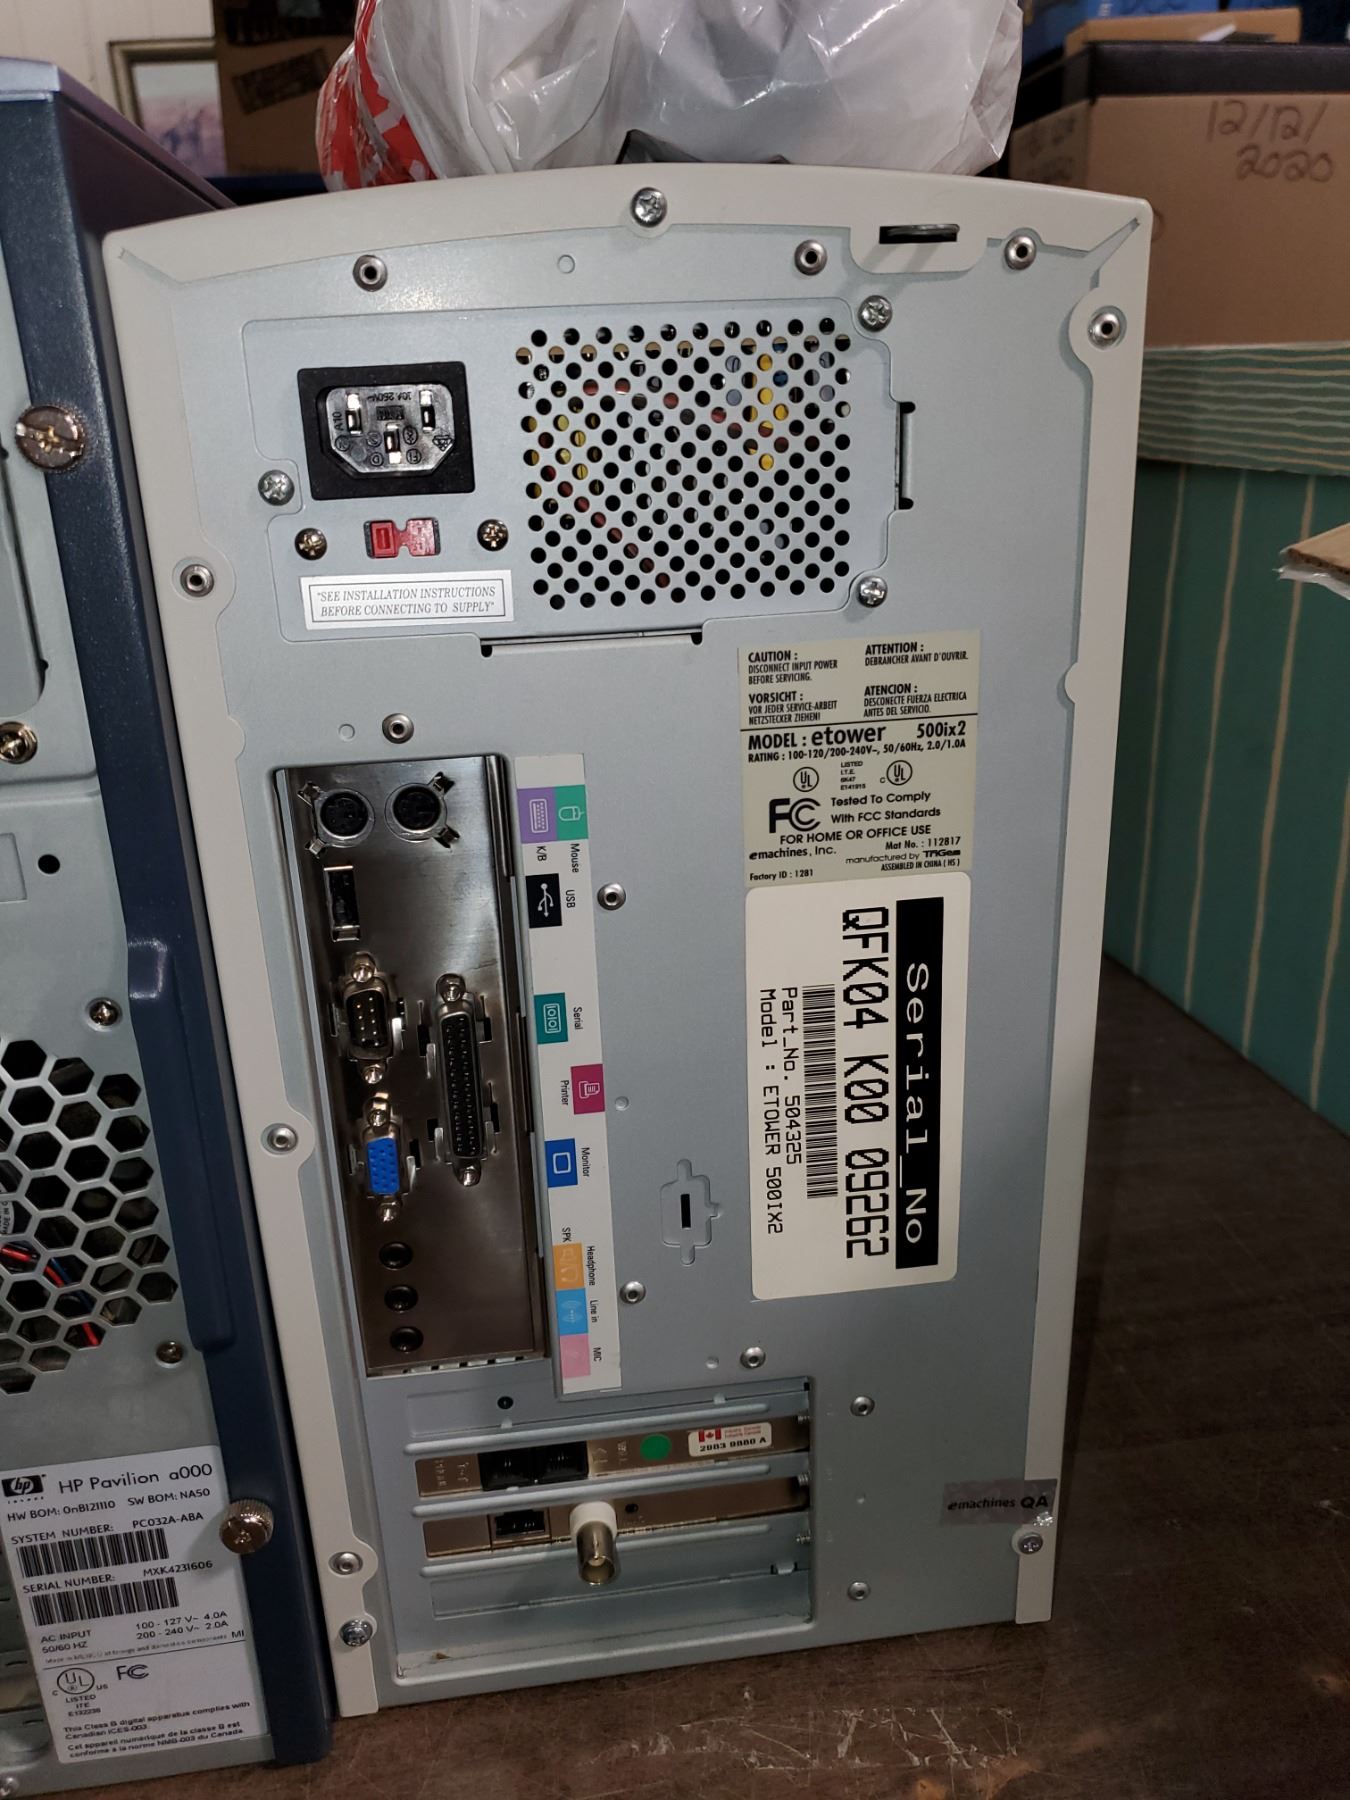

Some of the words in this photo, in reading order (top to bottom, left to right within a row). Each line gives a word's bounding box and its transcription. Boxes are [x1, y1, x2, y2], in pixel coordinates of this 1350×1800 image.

[1236, 144, 1335, 182] 2020
[343, 588, 418, 601] INSTALLATION
[420, 586, 496, 599] INSTRUCTIONS
[321, 605, 362, 617] BEFORE
[364, 602, 431, 616] CONNECTING
[434, 602, 448, 614] TO
[865, 641, 918, 655] ATTENTION
[748, 650, 791, 663] CAUTION
[865, 654, 909, 666] DEBRANCHER
[911, 653, 932, 663] AVANT
[748, 662, 790, 674] DISCONNECT
[792, 661, 812, 671] INPUT
[814, 660, 838, 670] POWER
[748, 674, 774, 685] BEFORE
[749, 691, 797, 704] VORSICHT
[864, 683, 912, 697] ATENCION
[864, 696, 905, 707] DESCONECTE
[907, 694, 932, 704] FUERZA
[934, 692, 967, 702] ELECTRICA
[749, 706, 762, 715] VOR
[765, 704, 784, 714] JEDER
[786, 700, 838, 712] SERVICE-ARBEIT
[864, 708, 884, 718] ANTES
[886, 706, 898, 716] DEL
[749, 714, 792, 726] NETZSTECKER
[748, 732, 797, 750] MODEL
[811, 726, 886, 747] etower
[917, 720, 966, 739] 500ix2
[748, 752, 779, 763] RATING
[927, 738, 966, 751] 2.0/1.0A
[831, 795, 867, 806] Tested
[870, 794, 882, 804] To
[886, 791, 931, 803] Comply
[830, 813, 854, 824] With
[858, 811, 882, 822] FCC
[885, 807, 941, 820] Standards
[780, 834, 804, 844] FOR
[807, 831, 842, 843] HOME
[846, 830, 863, 840] OR
[866, 826, 908, 838] OFFICE
[911, 825, 931, 835] USE
[886, 842, 902, 850] Mat
[904, 840, 918, 848] No.
[928, 836, 961, 847] 112817
[536, 846, 547, 862] K/B
[570, 843, 580, 873] Mouse
[815, 846, 836, 856] Inc.
[846, 852, 907, 864] manufactured
[909, 852, 920, 861] by
[881, 862, 914, 871] ASSEMBLED
[924, 860, 942, 868] CHINA
[750, 872, 776, 881] Factory
[795, 868, 813, 878] 1281
[566, 889, 576, 908] USB
[842, 906, 889, 1030] QFK04
[573, 1006, 582, 1030] Serial
[760, 988, 777, 1049] Model
[560, 1080, 570, 1106] Printer
[762, 1084, 781, 1157] ETOWER
[784, 1095, 802, 1166] 504325
[581, 1147, 590, 1177] Monitor
[766, 1166, 784, 1235] 500IX2
[845, 1147, 890, 1259] 09262
[562, 1227, 572, 1242] SPK
[587, 1246, 596, 1286] Headphone
[589, 1300, 597, 1315] Line
[591, 1316, 598, 1324] in
[593, 1346, 602, 1362] MIC
[760, 1436, 767, 1444] A
[59, 1478, 84, 1494] HP
[90, 1472, 160, 1490] Pavilion
[169, 1464, 212, 1480] a000
[8, 1512, 26, 1522] HW
[30, 1508, 60, 1518] BOM:
[128, 1496, 144, 1506] SW
[148, 1492, 178, 1504] BOM:
[948, 1497, 1016, 1510] emachines
[1020, 1496, 1048, 1509] QA
[11, 1531, 56, 1544] SYSTEM
[62, 1524, 114, 1538] NUMBER:
[22, 1581, 62, 1594] SERIAL
[64, 1574, 115, 1587] NUMBER:
[136, 1621, 154, 1630] 100
[164, 1617, 182, 1626] 127
[204, 1611, 228, 1620] 4.0A
[40, 1635, 56, 1644] AC
[60, 1630, 92, 1640] INPUT
[136, 1631, 156, 1640] 200
[165, 1627, 184, 1636] 240
[205, 1620, 228, 1630] 2.0A
[42, 1644, 71, 1654] 50/60
[73, 1641, 88, 1649] HZ
[66, 1694, 96, 1703] LISTED
[84, 1722, 108, 1730] Class
[120, 1716, 145, 1726] digital
[147, 1712, 190, 1722] apparatus
[192, 1705, 230, 1714] complies
[66, 1730, 106, 1740] Canadian
[84, 1740, 118, 1749] appareil
[190, 1726, 216, 1734] classe
